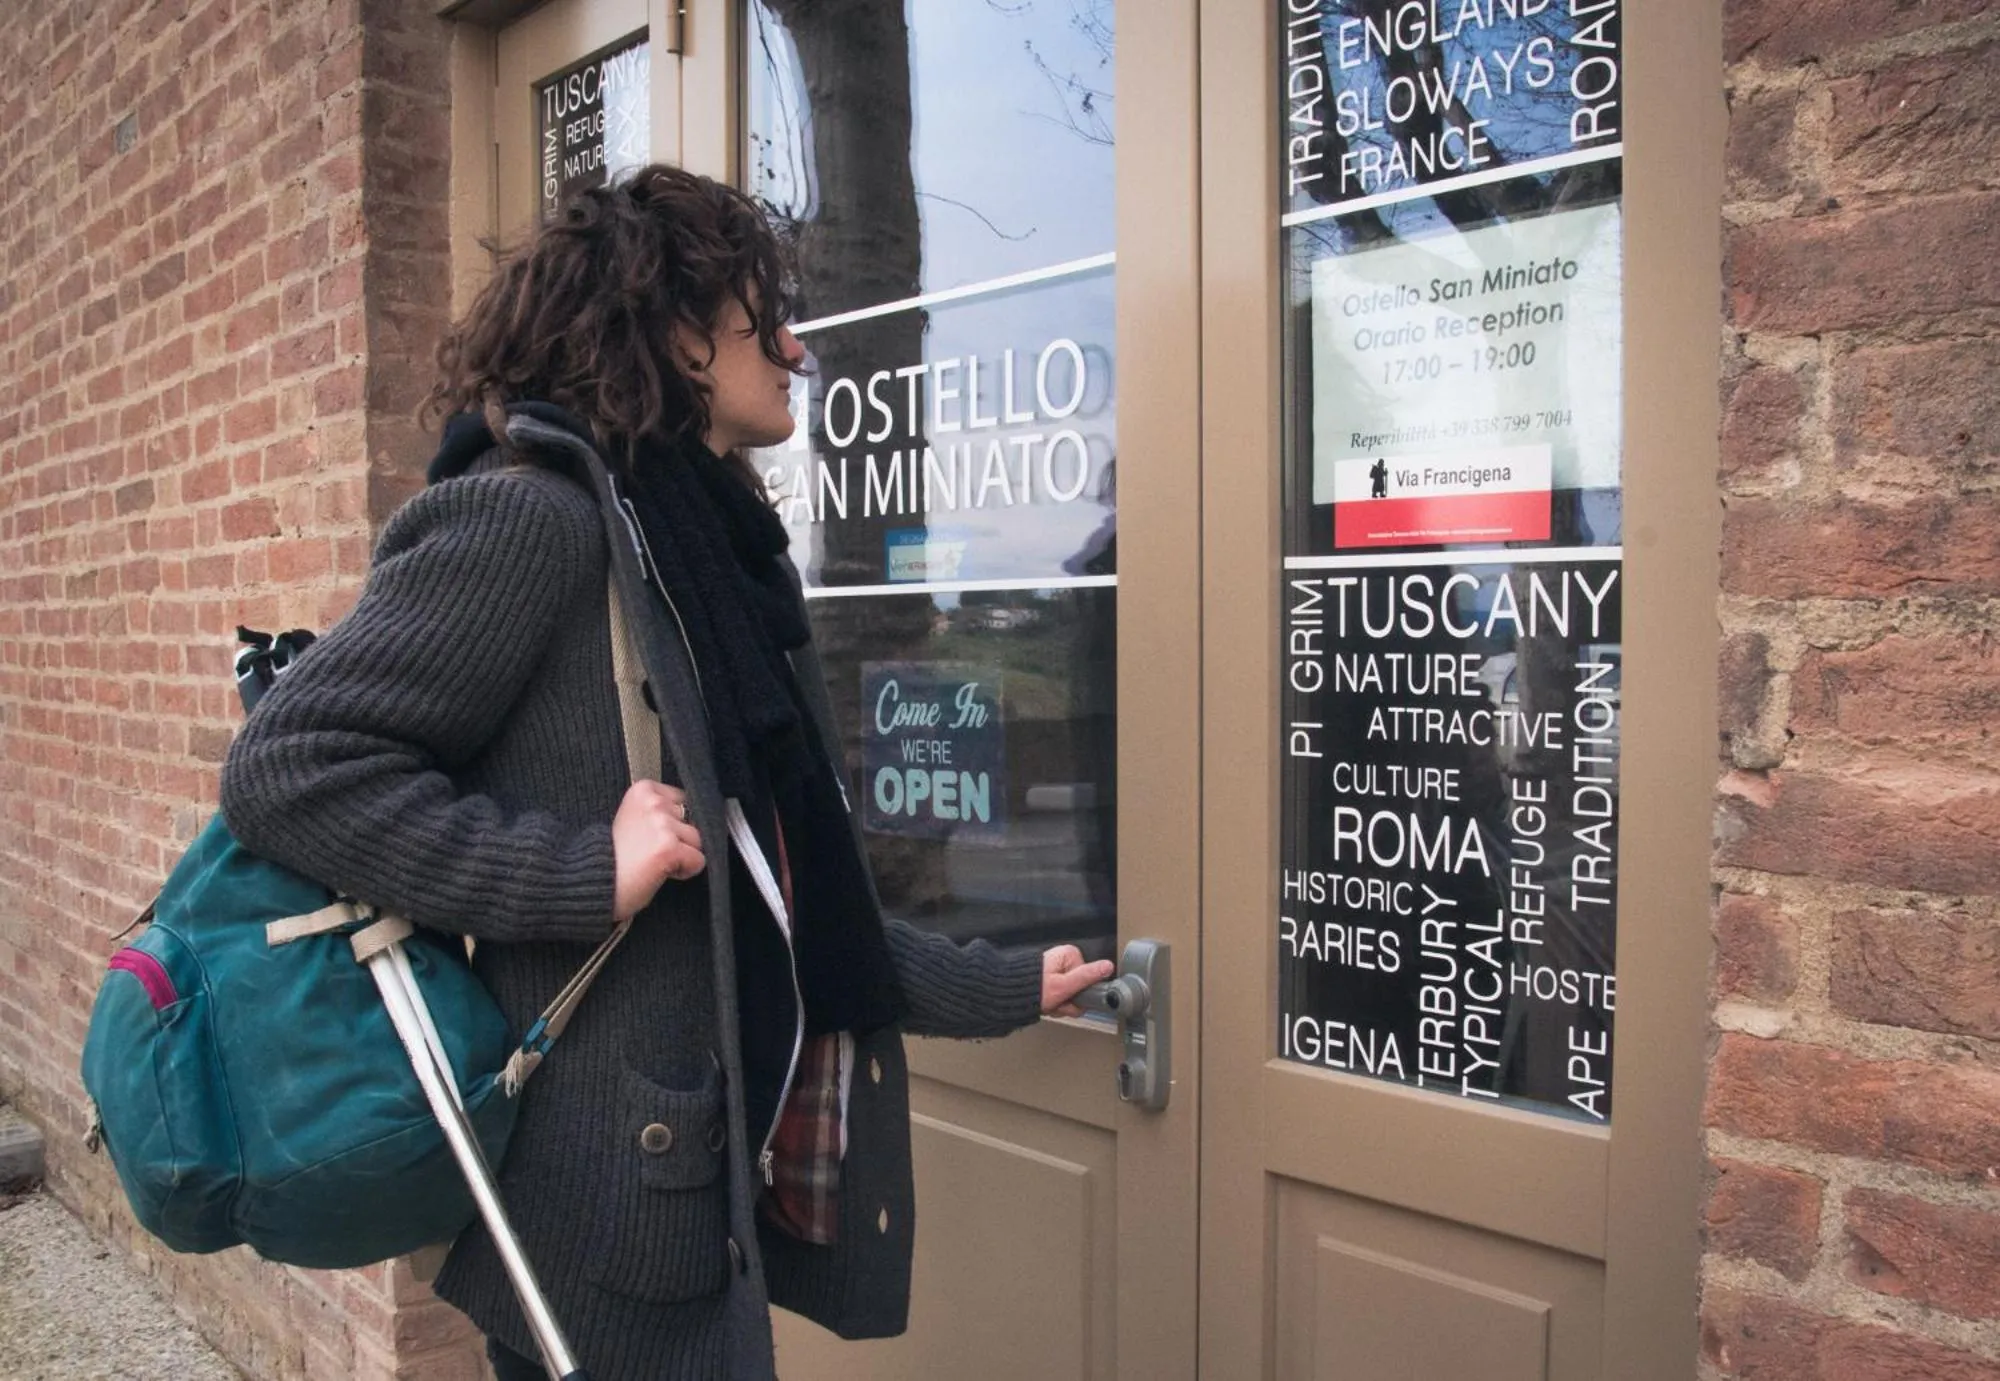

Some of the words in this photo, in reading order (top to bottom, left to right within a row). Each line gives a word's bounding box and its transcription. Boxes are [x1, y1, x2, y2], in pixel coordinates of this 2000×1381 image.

[543, 43, 641, 123] TUSCANY
[1335, 36, 1553, 137] SLOWAYS
[544, 128, 560, 219] ILGRIM
[1340, 119, 1491, 194] FRANCE
[1428, 277, 1473, 304] San
[1480, 256, 1579, 295] Miniato
[1354, 324, 1426, 352] Orario
[1434, 302, 1564, 340] Reception
[823, 338, 1086, 448] OSTELLO
[1383, 354, 1441, 385] 17:00
[1472, 341, 1535, 371] 19:00
[1503, 413, 1531, 434] 799
[863, 429, 1090, 518] MINIATO
[1395, 470, 1419, 487] Via
[1423, 465, 1512, 488] Francigena
[1327, 569, 1618, 639] TUSCANY
[875, 679, 941, 735] Come
[949, 682, 989, 729] In
[1335, 653, 1482, 697] NATURE
[900, 739, 953, 765] WE'RE
[1367, 706, 1564, 749] ATTRACTIVE
[874, 766, 991, 823] OPEN
[1332, 762, 1461, 801] CULTURE
[1571, 662, 1614, 912] TRADITION
[1333, 806, 1491, 878] ROMA
[1510, 778, 1547, 945] REFUGE
[1284, 868, 1414, 916] HISTORIC
[1280, 916, 1401, 973] RARIES
[1418, 883, 1458, 1087] ERBURY
[1462, 909, 1503, 1098] TYPICAL
[1284, 1013, 1406, 1080] IGENA
[1567, 1025, 1608, 1120] APE
